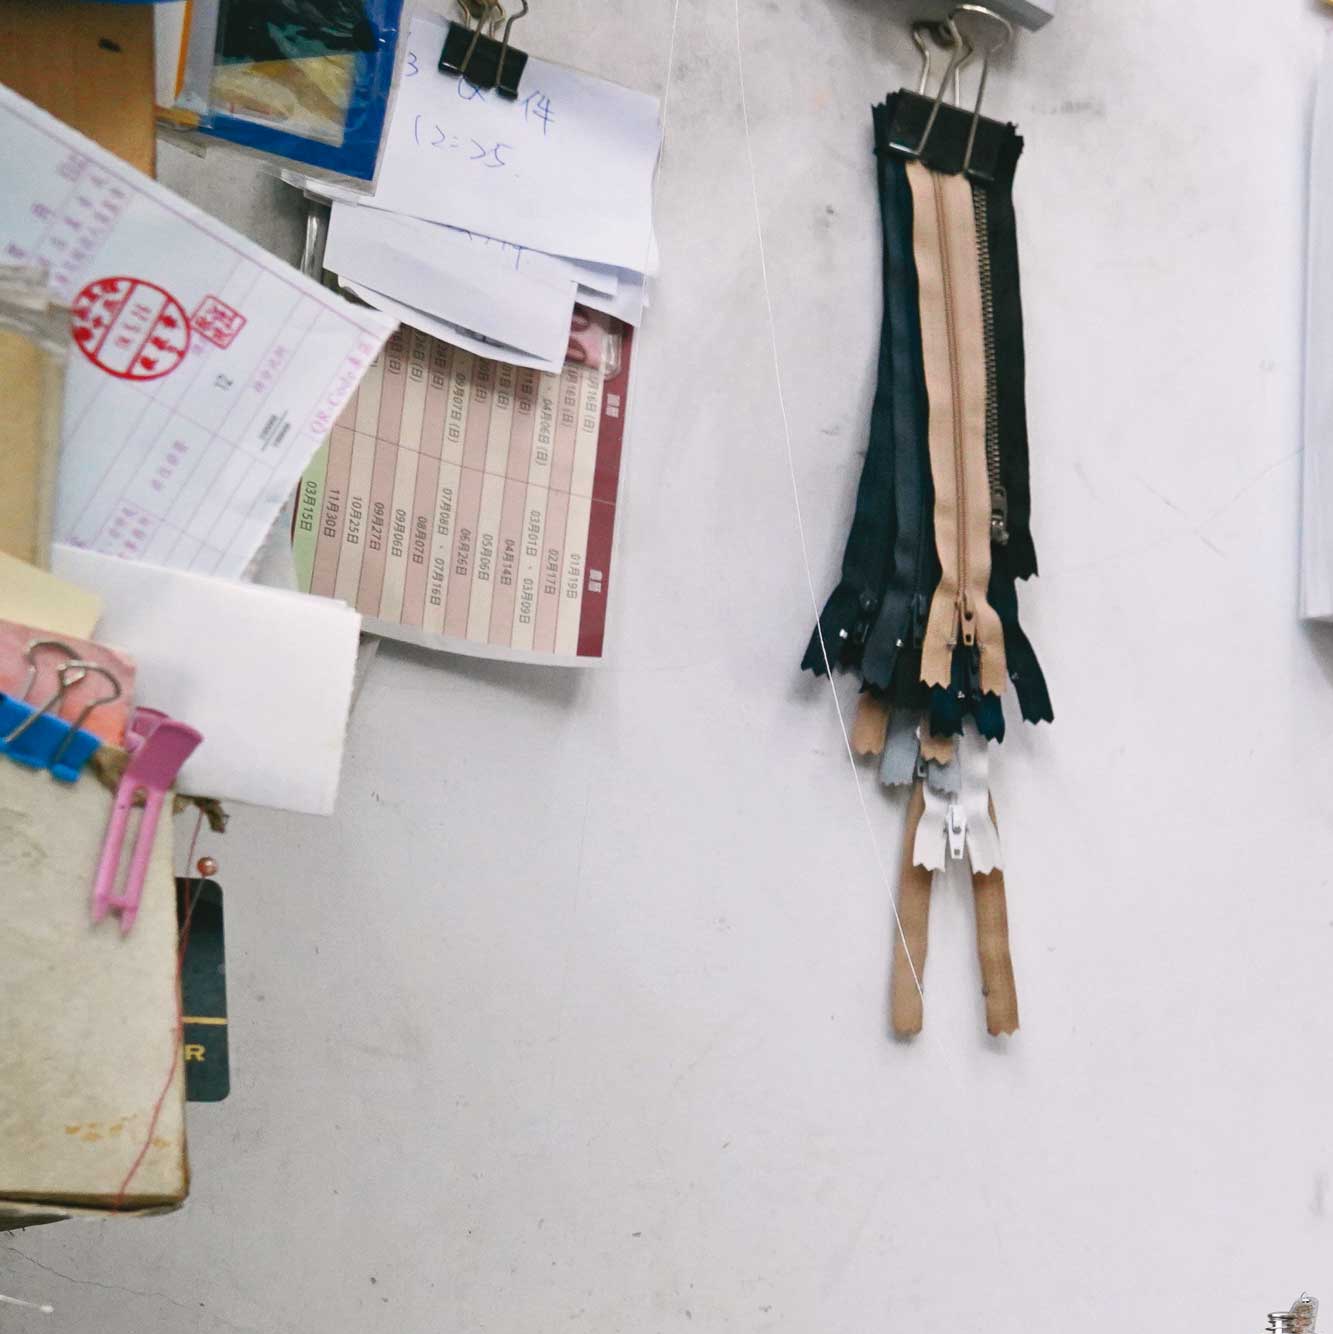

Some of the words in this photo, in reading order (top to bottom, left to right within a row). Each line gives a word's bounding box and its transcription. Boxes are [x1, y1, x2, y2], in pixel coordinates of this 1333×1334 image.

[300, 481, 317, 532] 03月15日
[323, 489, 340, 538] 11月30日
[347, 496, 362, 545] 10月25日
[369, 502, 385, 551] 09月27日
[391, 508, 406, 557] 09月06日
[412, 516, 428, 564] 08月07日
[456, 528, 471, 576] 06月26日
[478, 534, 494, 581] 05月06日
[500, 538, 515, 586] 04月14日
[544, 549, 559, 595] 02月17日
[567, 553, 581, 599] 01月19日
